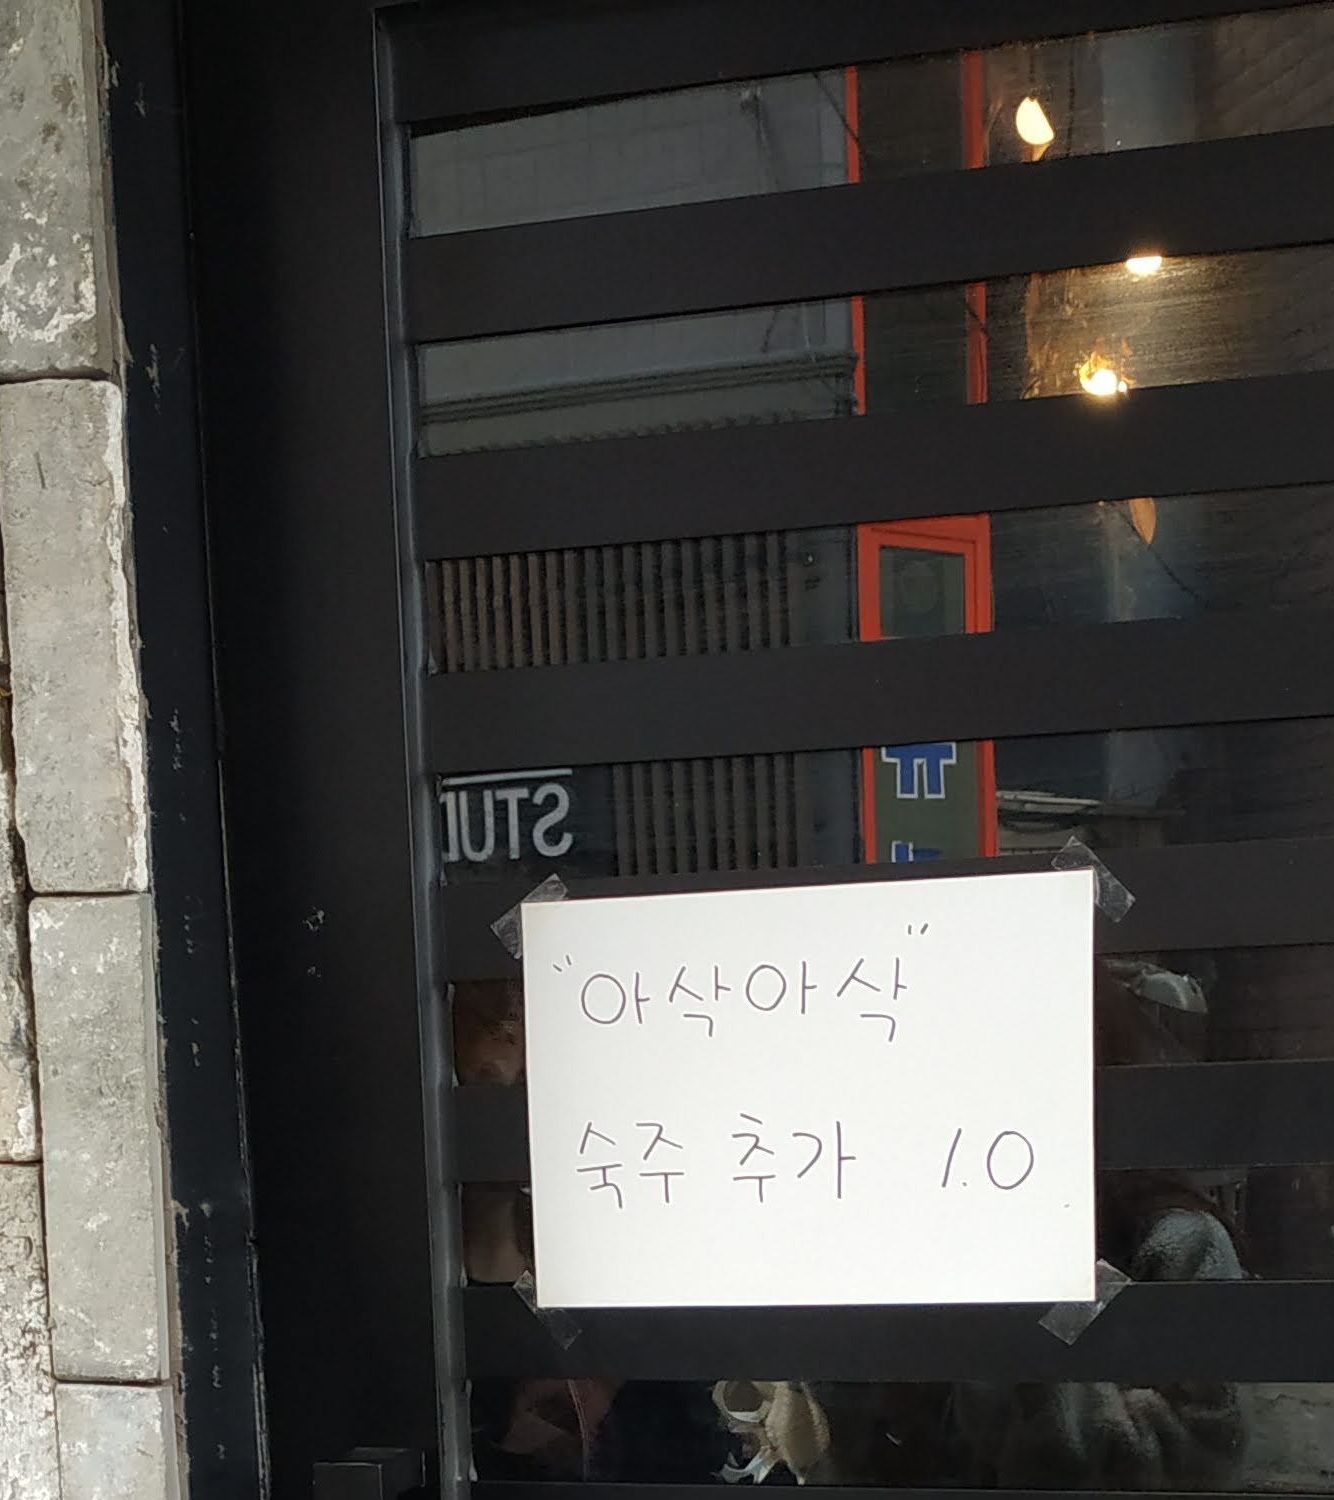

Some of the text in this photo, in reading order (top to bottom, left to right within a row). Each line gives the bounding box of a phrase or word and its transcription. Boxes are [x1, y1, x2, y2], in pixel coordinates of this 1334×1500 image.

[576, 1112, 1035, 1209] 숙주 추가 1.0
